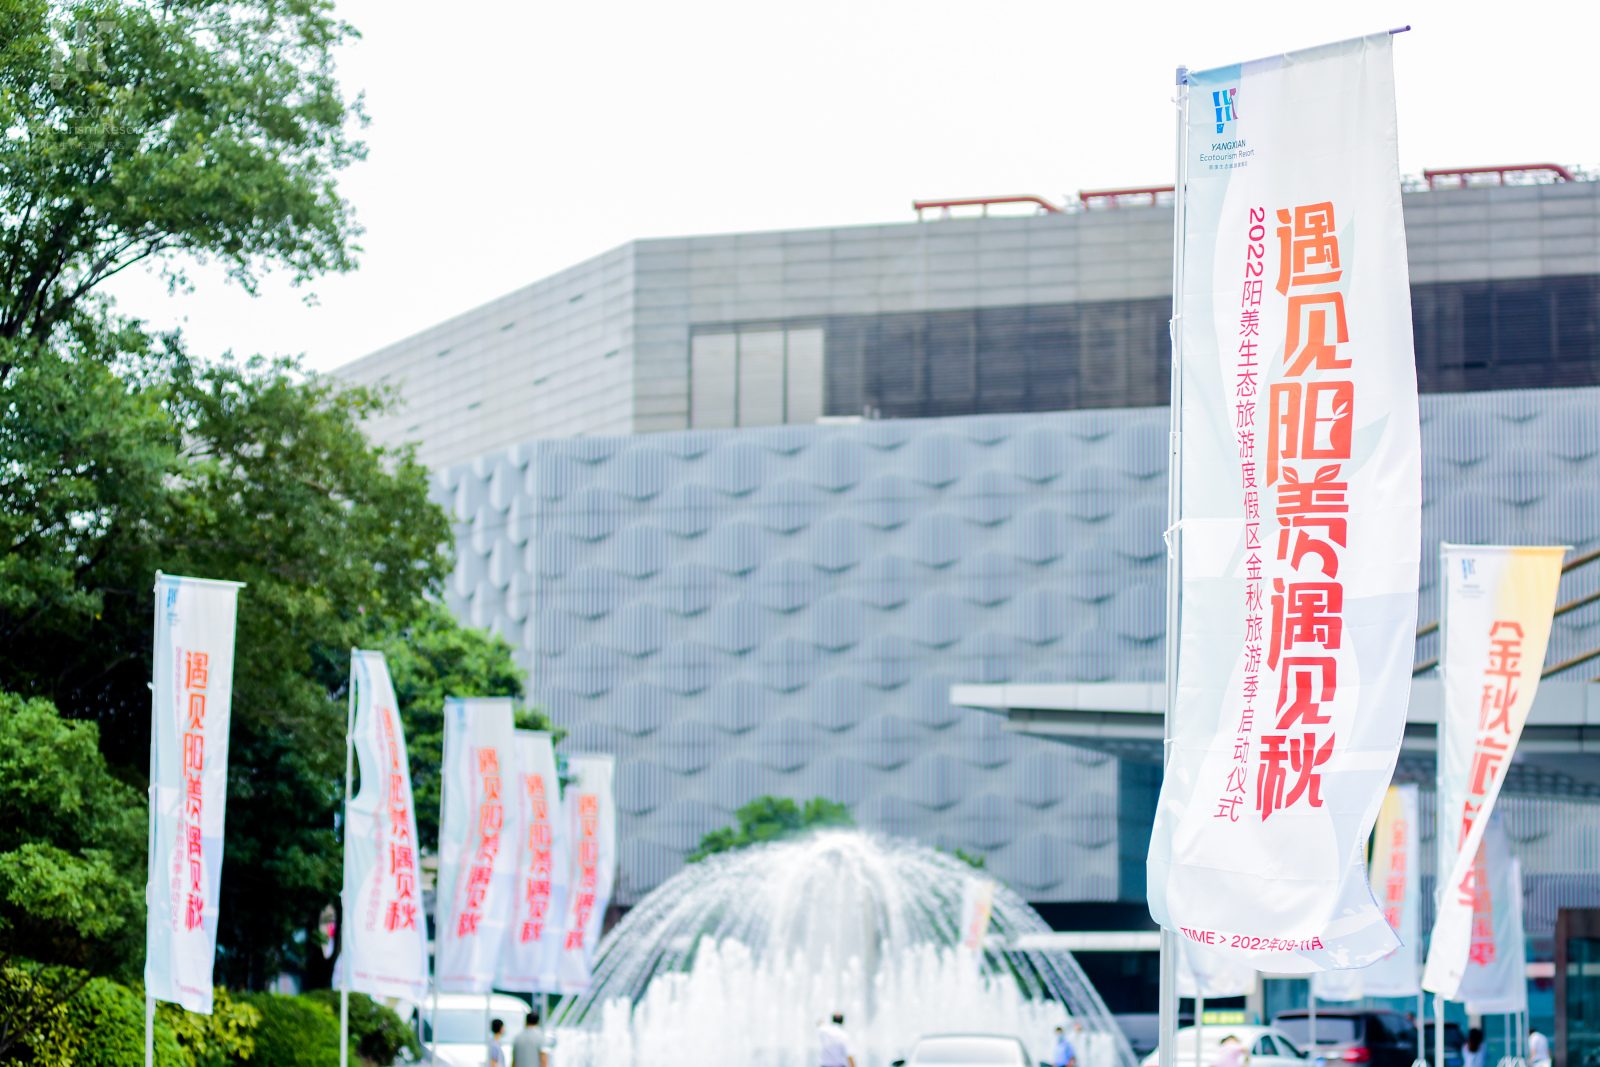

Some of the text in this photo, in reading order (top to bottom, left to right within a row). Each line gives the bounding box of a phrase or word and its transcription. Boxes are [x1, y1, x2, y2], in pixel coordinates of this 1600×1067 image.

[1212, 140, 1246, 151] YANGXIAN
[1200, 153, 1237, 162] Ecotourism
[1214, 206, 1266, 823] 2022阳羡生态旅游度假区金秋旅游季启动仪式
[1256, 200, 1354, 823] 遇见阳羡遇见秋
[1180, 927, 1215, 945] TIME
